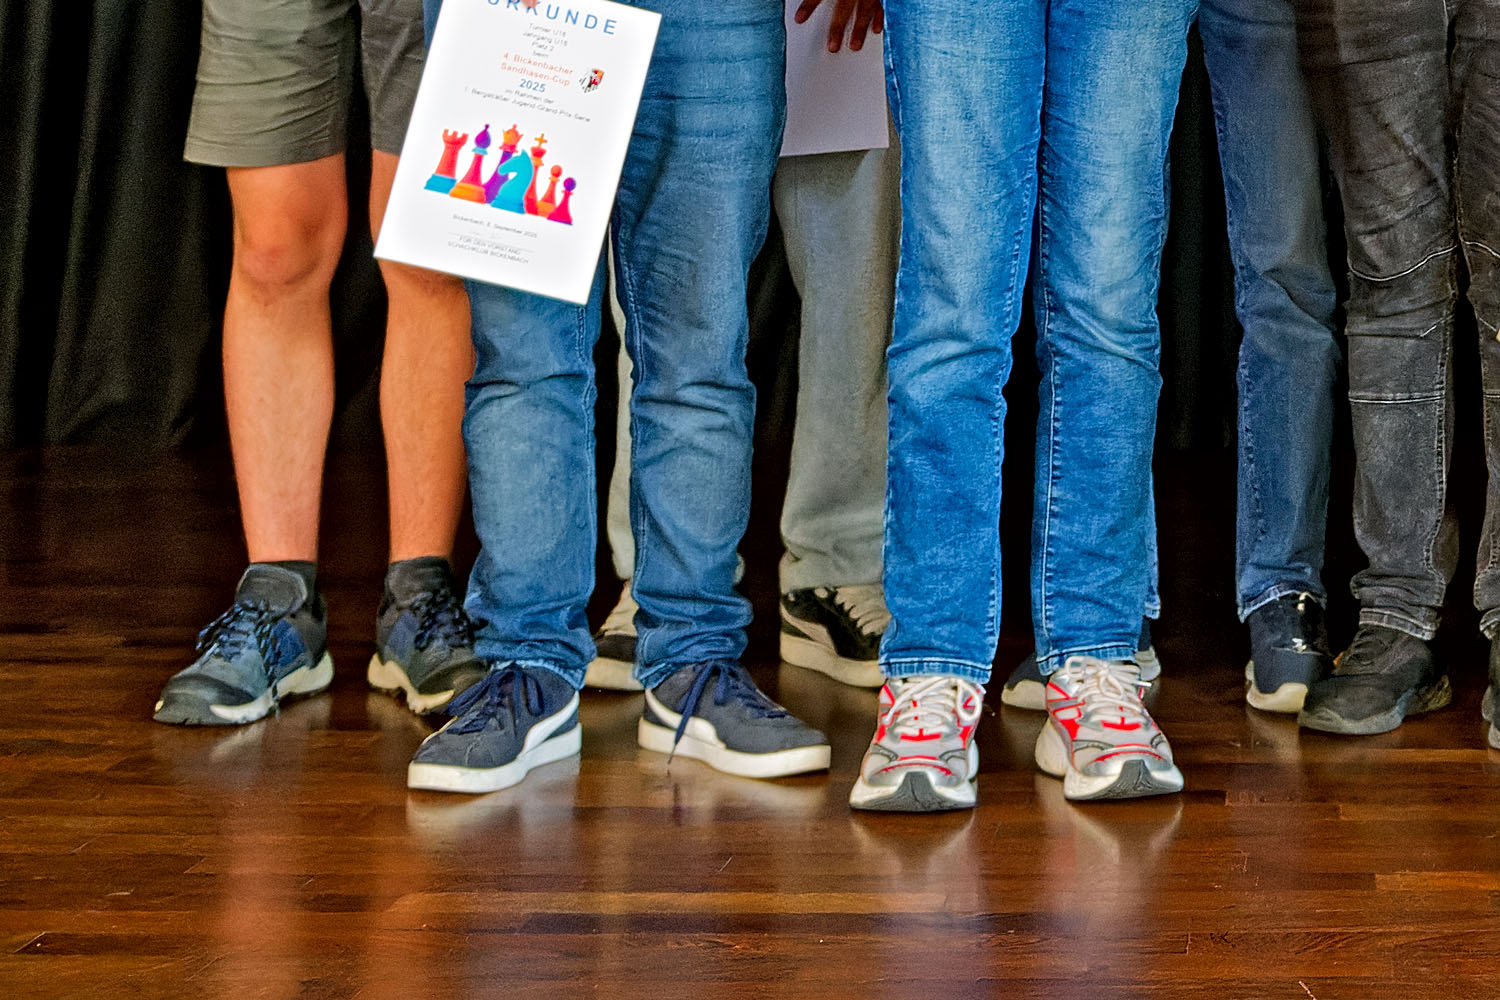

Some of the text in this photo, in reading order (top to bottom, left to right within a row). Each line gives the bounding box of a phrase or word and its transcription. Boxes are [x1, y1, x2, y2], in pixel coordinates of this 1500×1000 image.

[499, 61, 571, 87] Sandhasen-Cup
[502, 51, 574, 76] 4. Bickenbacher
[518, 77, 547, 93] 2025
